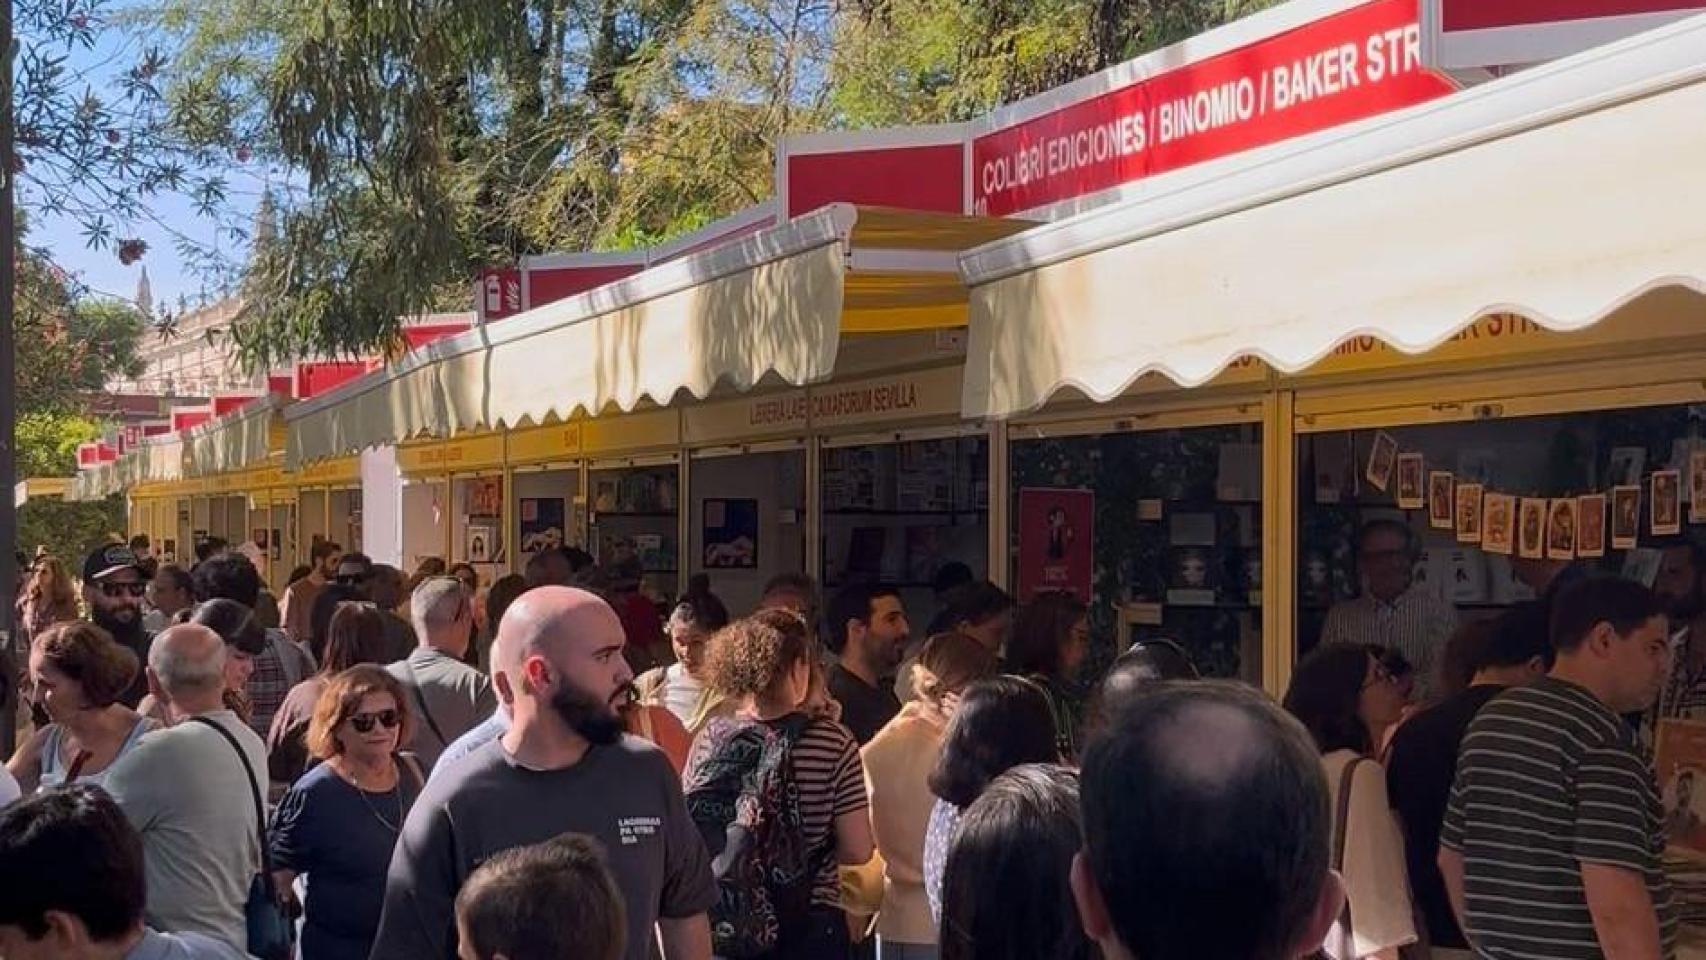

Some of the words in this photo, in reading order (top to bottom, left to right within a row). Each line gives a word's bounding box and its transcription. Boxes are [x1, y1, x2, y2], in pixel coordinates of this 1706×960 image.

[982, 136, 1045, 194] COLIBRÍ
[1048, 114, 1145, 174] EDICIONES
[1160, 78, 1254, 142] BINOMIO
[1272, 43, 1359, 111] BAKER
[873, 382, 917, 411] SEVILLA
